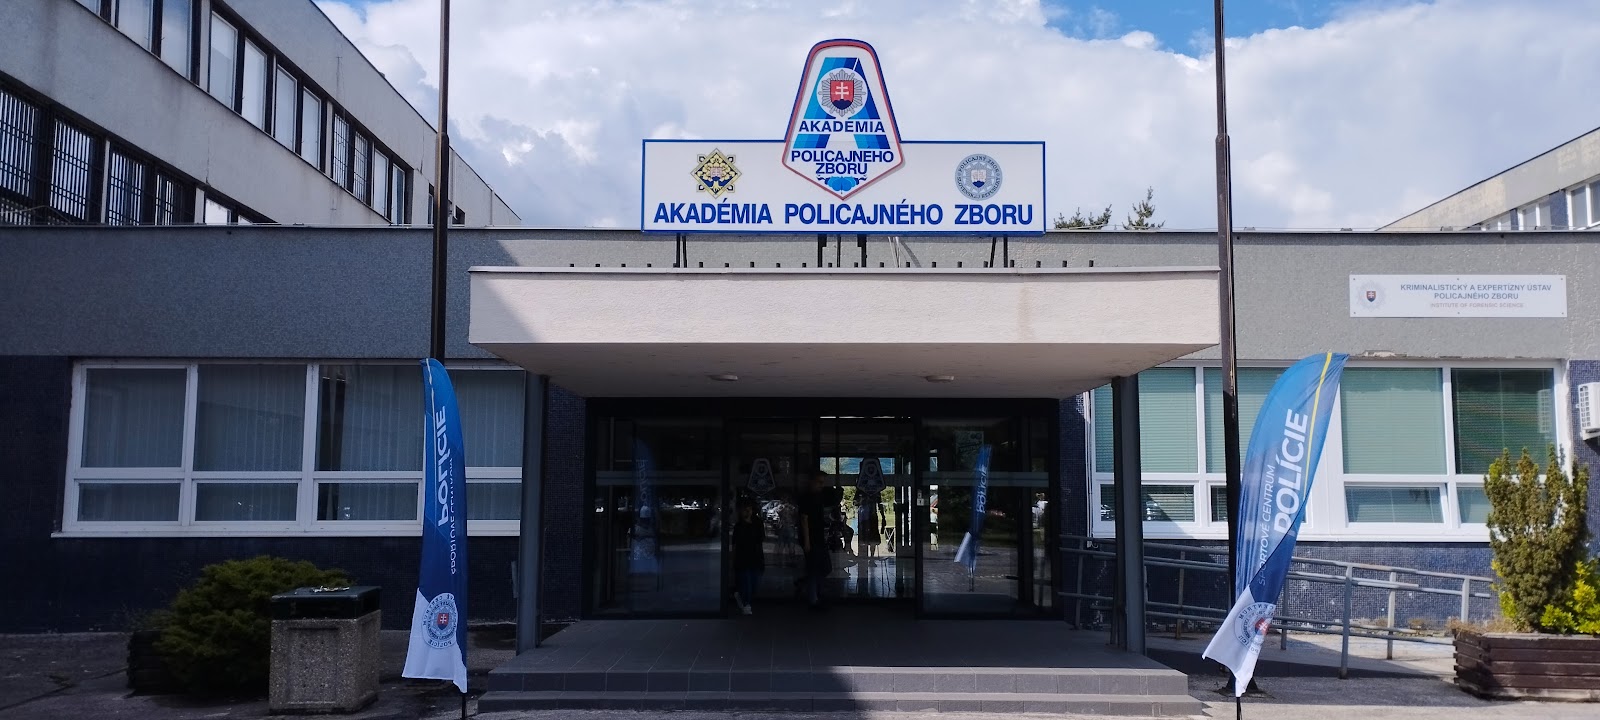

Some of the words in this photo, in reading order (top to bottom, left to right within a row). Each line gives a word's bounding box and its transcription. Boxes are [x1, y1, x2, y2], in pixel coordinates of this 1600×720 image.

[815, 163, 868, 175] ZBORU
[654, 198, 773, 225] AKADÉMIA
[784, 199, 943, 226] POLICAJNÉHO
[954, 203, 1033, 226] ZBORU
[1434, 291, 1490, 300] POLICAJNÉHO
[1491, 292, 1519, 300] ZBORU
[1477, 283, 1525, 291] EXPERTÍZNY
[1527, 283, 1552, 291] ÚSTAV
[1273, 408, 1309, 537] POLÍCIE
[1262, 464, 1276, 522] CENTRUM
[1258, 523, 1271, 586] SPORTOVÉ
